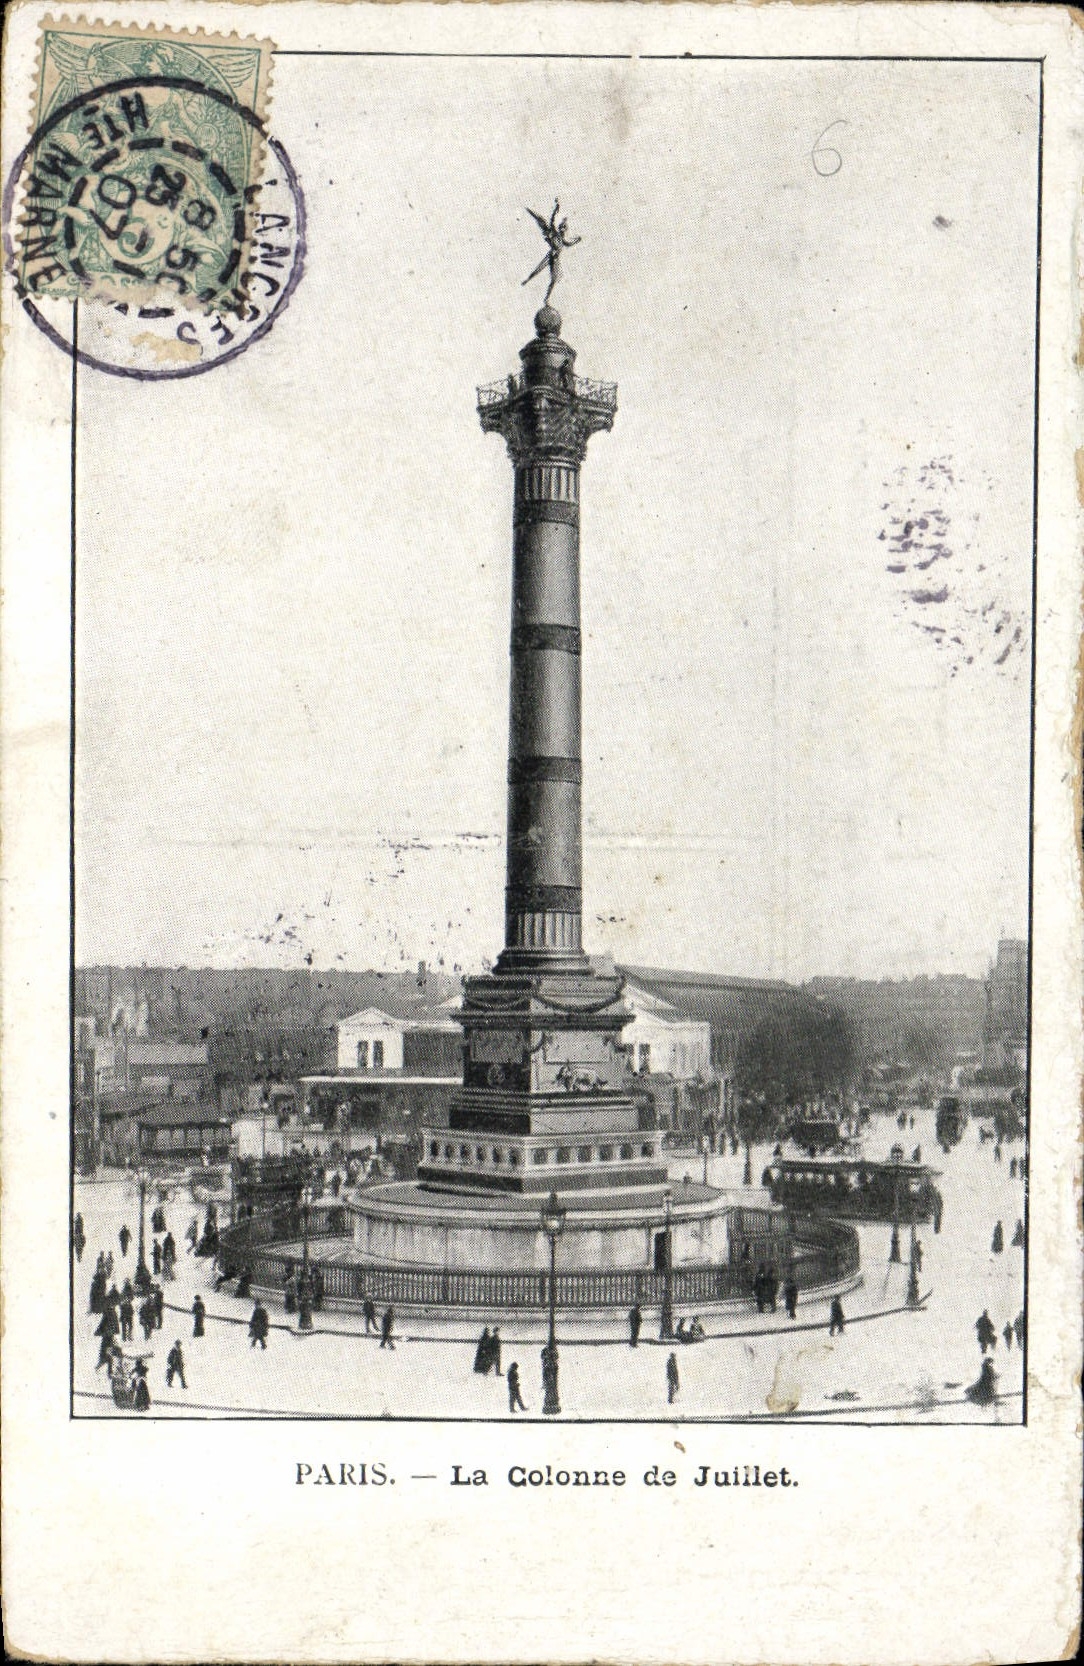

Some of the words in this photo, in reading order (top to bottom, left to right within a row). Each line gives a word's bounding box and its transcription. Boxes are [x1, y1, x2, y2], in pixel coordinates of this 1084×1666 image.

[811, 119, 848, 177] 6
[21, 143, 83, 291] MARNE
[89, 175, 137, 240] 07
[184, 200, 216, 231] 8
[295, 1462, 396, 1486] PARIS.
[450, 1465, 488, 1487] La
[507, 1465, 626, 1488] Colonne
[643, 1465, 677, 1487] de
[694, 1465, 799, 1488] Juillet.
